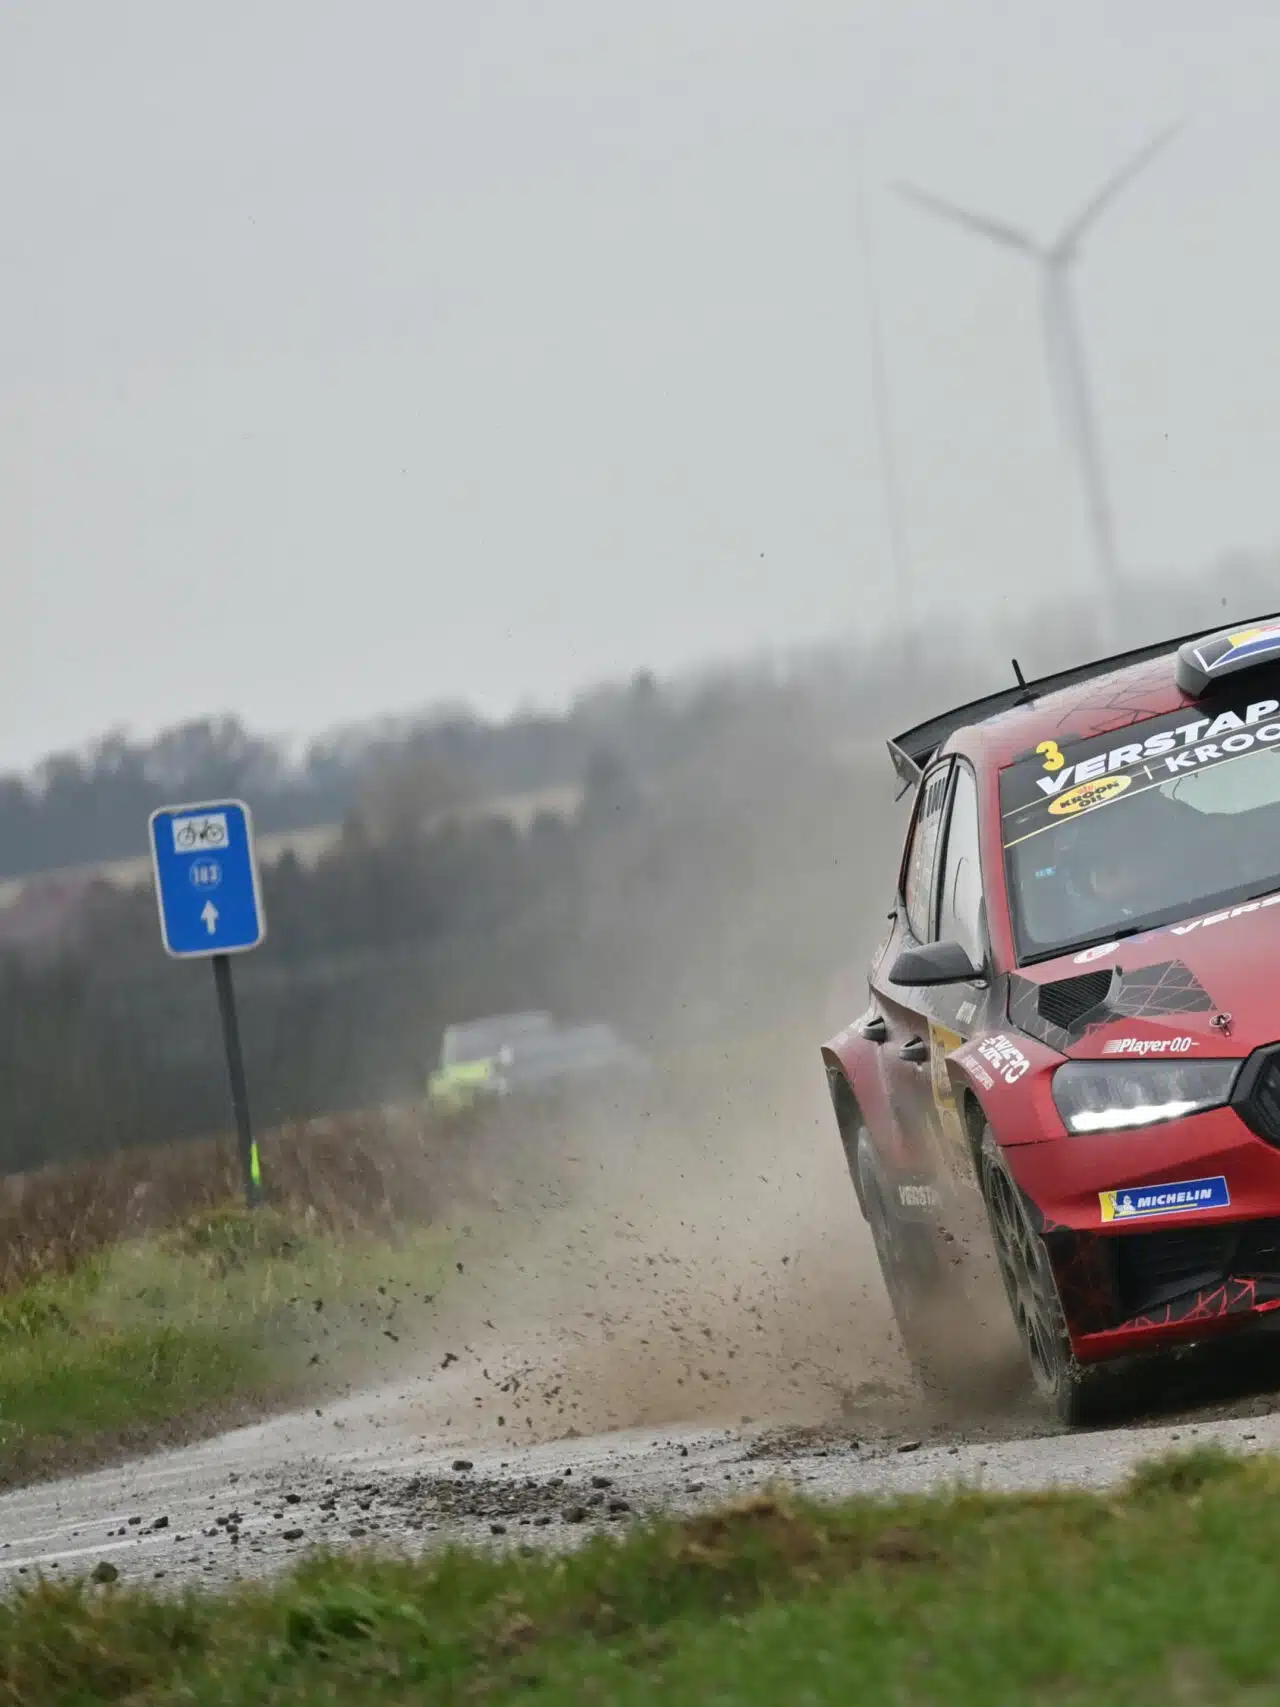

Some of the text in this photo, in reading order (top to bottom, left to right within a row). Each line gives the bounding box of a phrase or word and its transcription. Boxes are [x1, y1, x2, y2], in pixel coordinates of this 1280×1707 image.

[1036, 740, 1065, 771] 3
[1059, 780, 1120, 809] KROON
[1078, 794, 1106, 808] OIL
[1118, 1038, 1171, 1055] Player
[1136, 1187, 1213, 1208] MICHELIN
